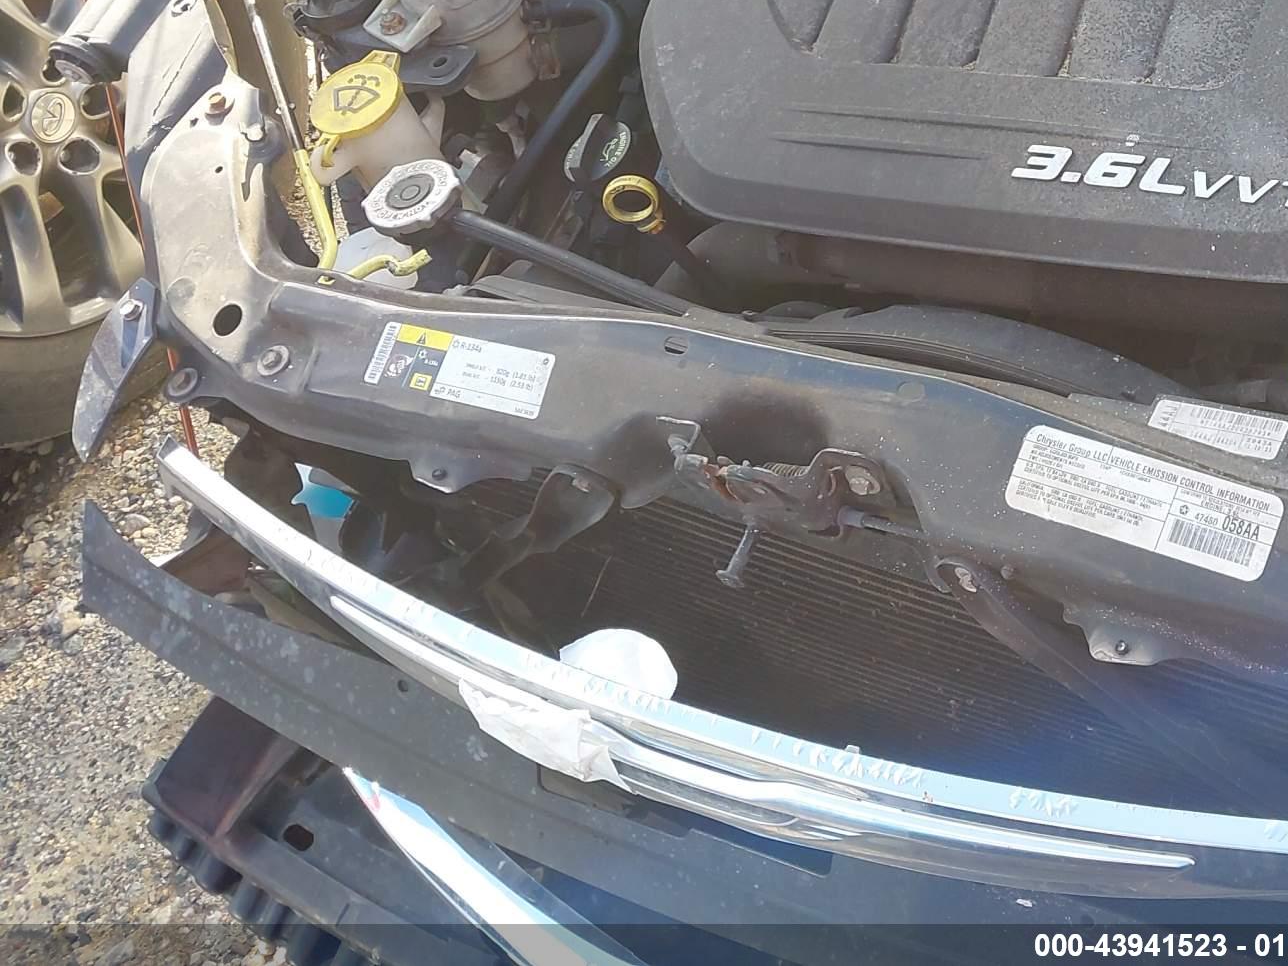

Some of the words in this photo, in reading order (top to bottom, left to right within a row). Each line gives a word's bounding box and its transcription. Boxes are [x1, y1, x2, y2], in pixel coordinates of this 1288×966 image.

[1011, 144, 1186, 195] 3.6L
[1034, 432, 1068, 452] Chrysler
[1066, 442, 1093, 459] Group
[1091, 449, 1109, 462] LLC
[1108, 454, 1142, 472] VEHICLE
[1141, 464, 1179, 484] EMISSION
[1178, 475, 1216, 495] CONTROL
[1214, 487, 1271, 512] INFORMATION
[1219, 513, 1263, 541] 058AA
